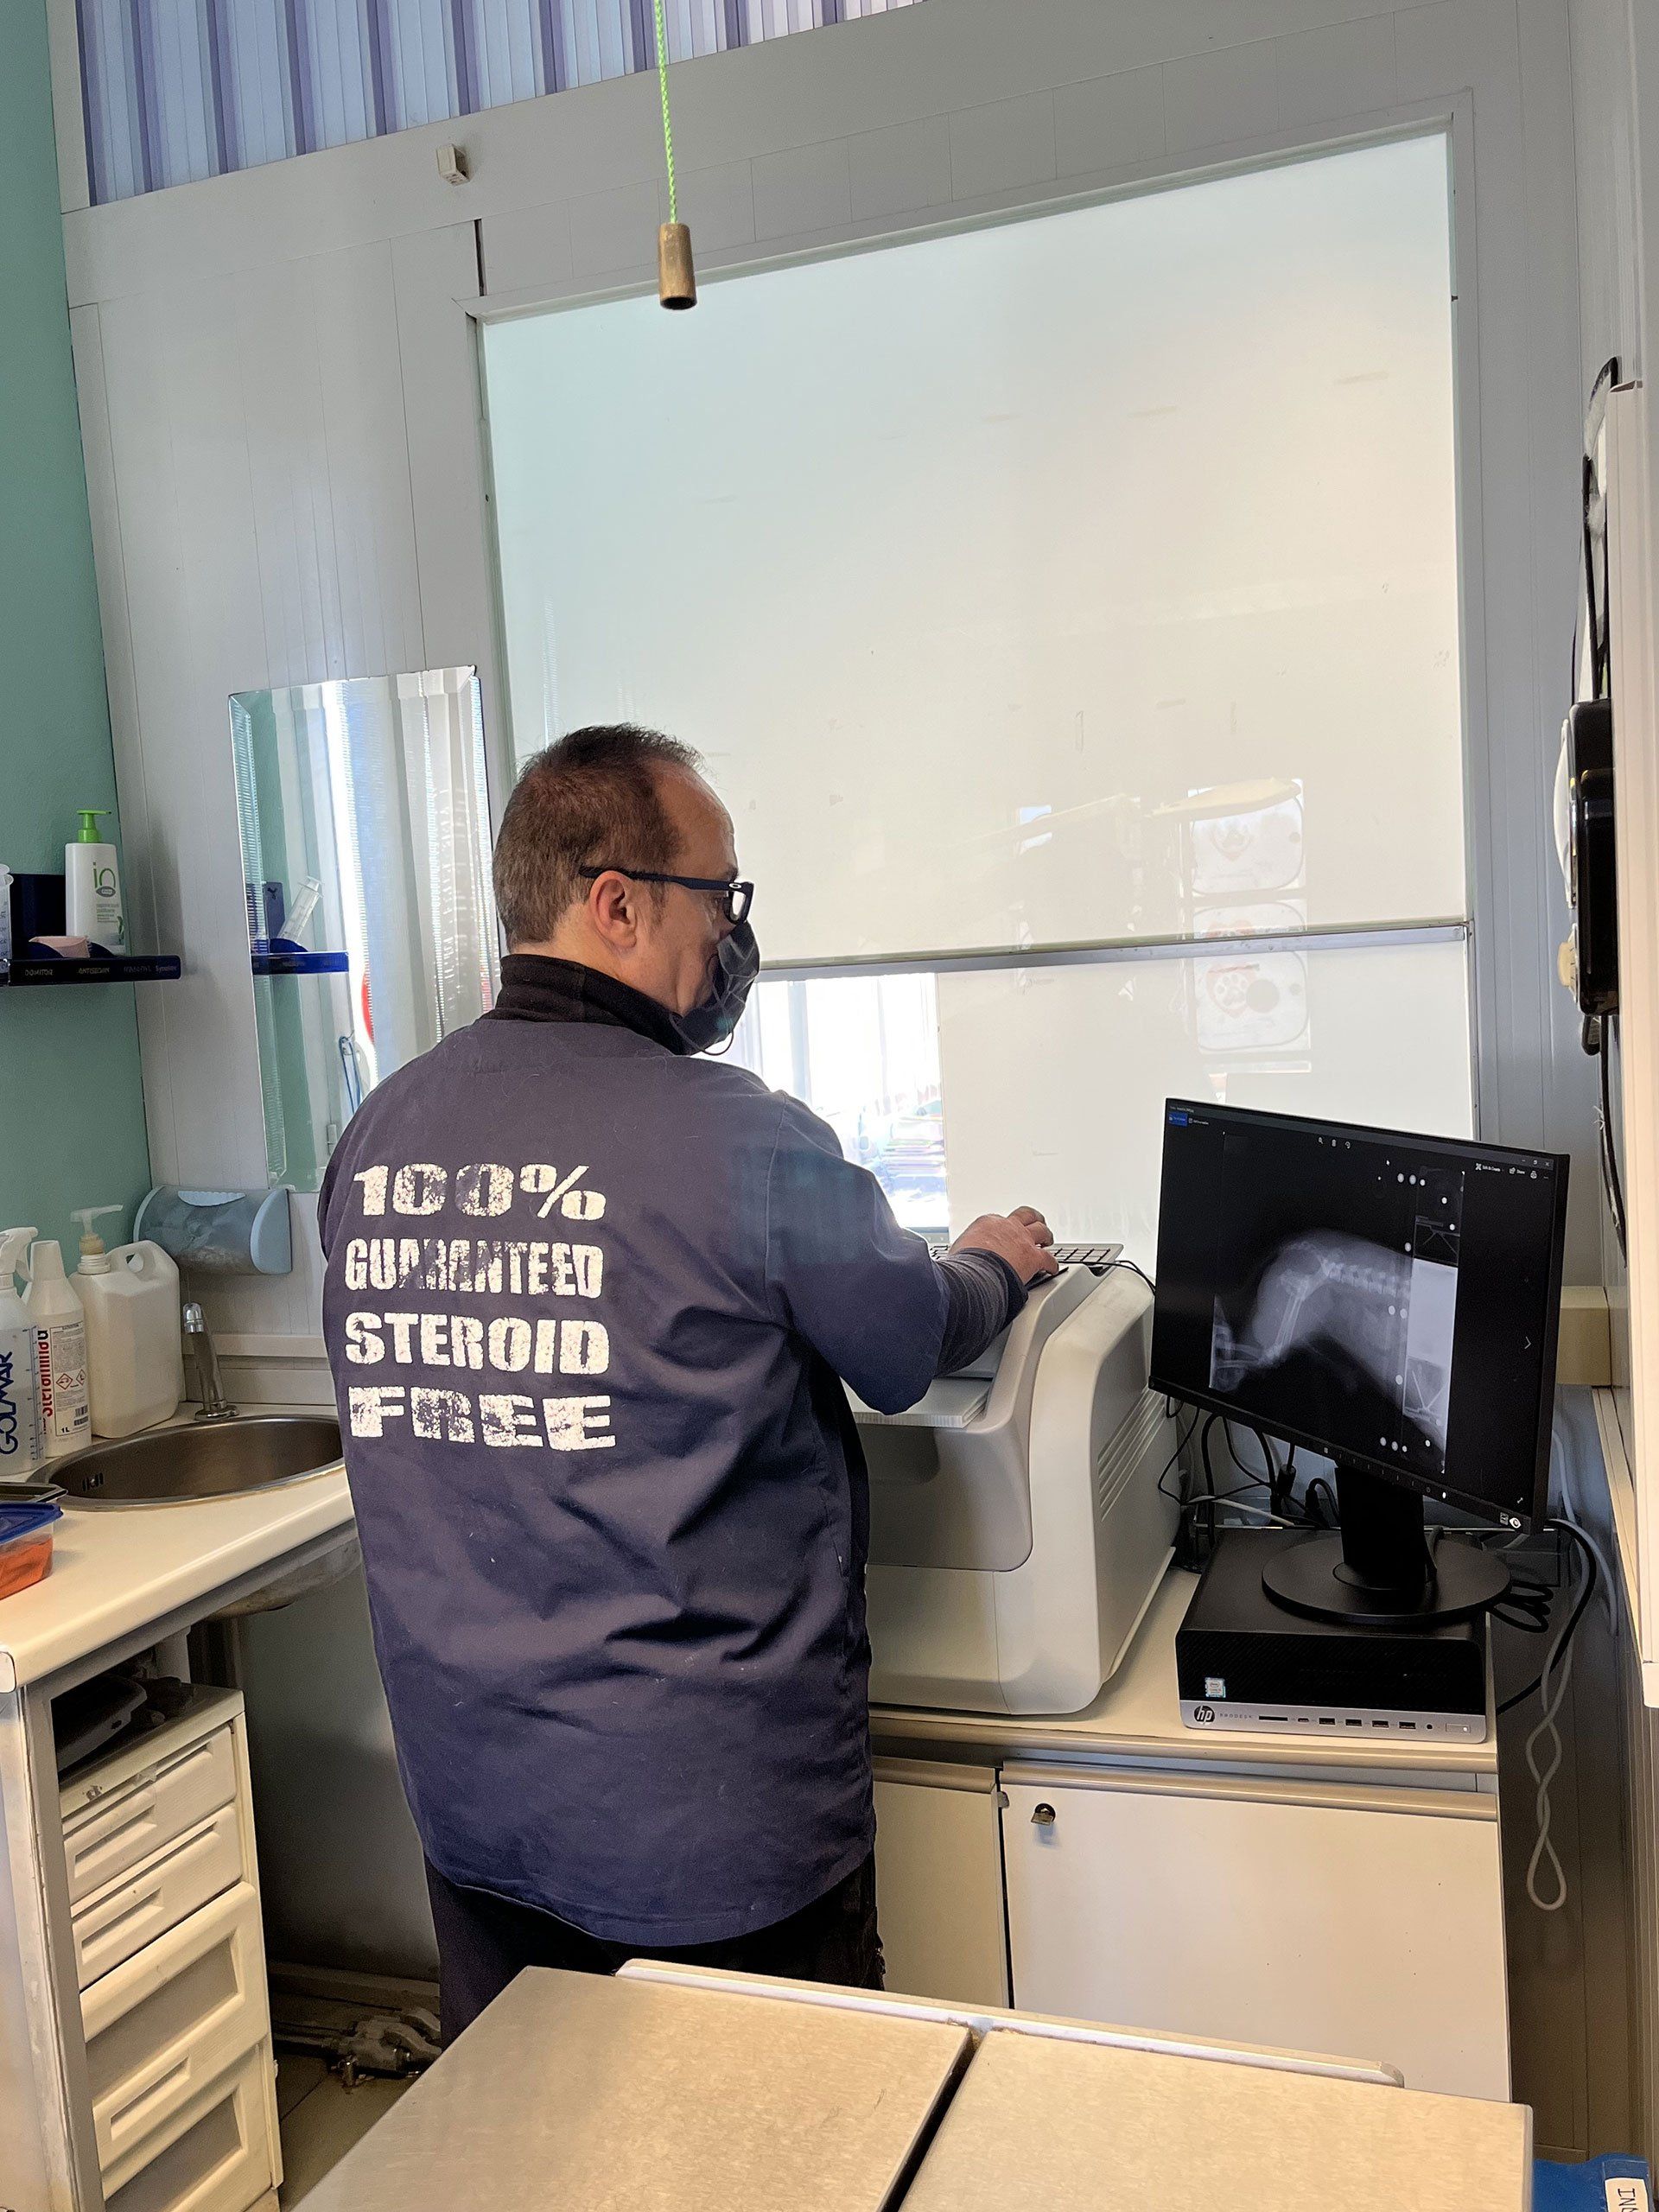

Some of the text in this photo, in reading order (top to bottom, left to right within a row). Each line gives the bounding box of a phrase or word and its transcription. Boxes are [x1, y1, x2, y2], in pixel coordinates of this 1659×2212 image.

[353, 1163, 607, 1221] 100%
[345, 1238, 604, 1299] GUARANTEED
[346, 1312, 611, 1375] STEROID
[348, 1386, 616, 1452] FREE
[1194, 1705, 1215, 1725] hp
